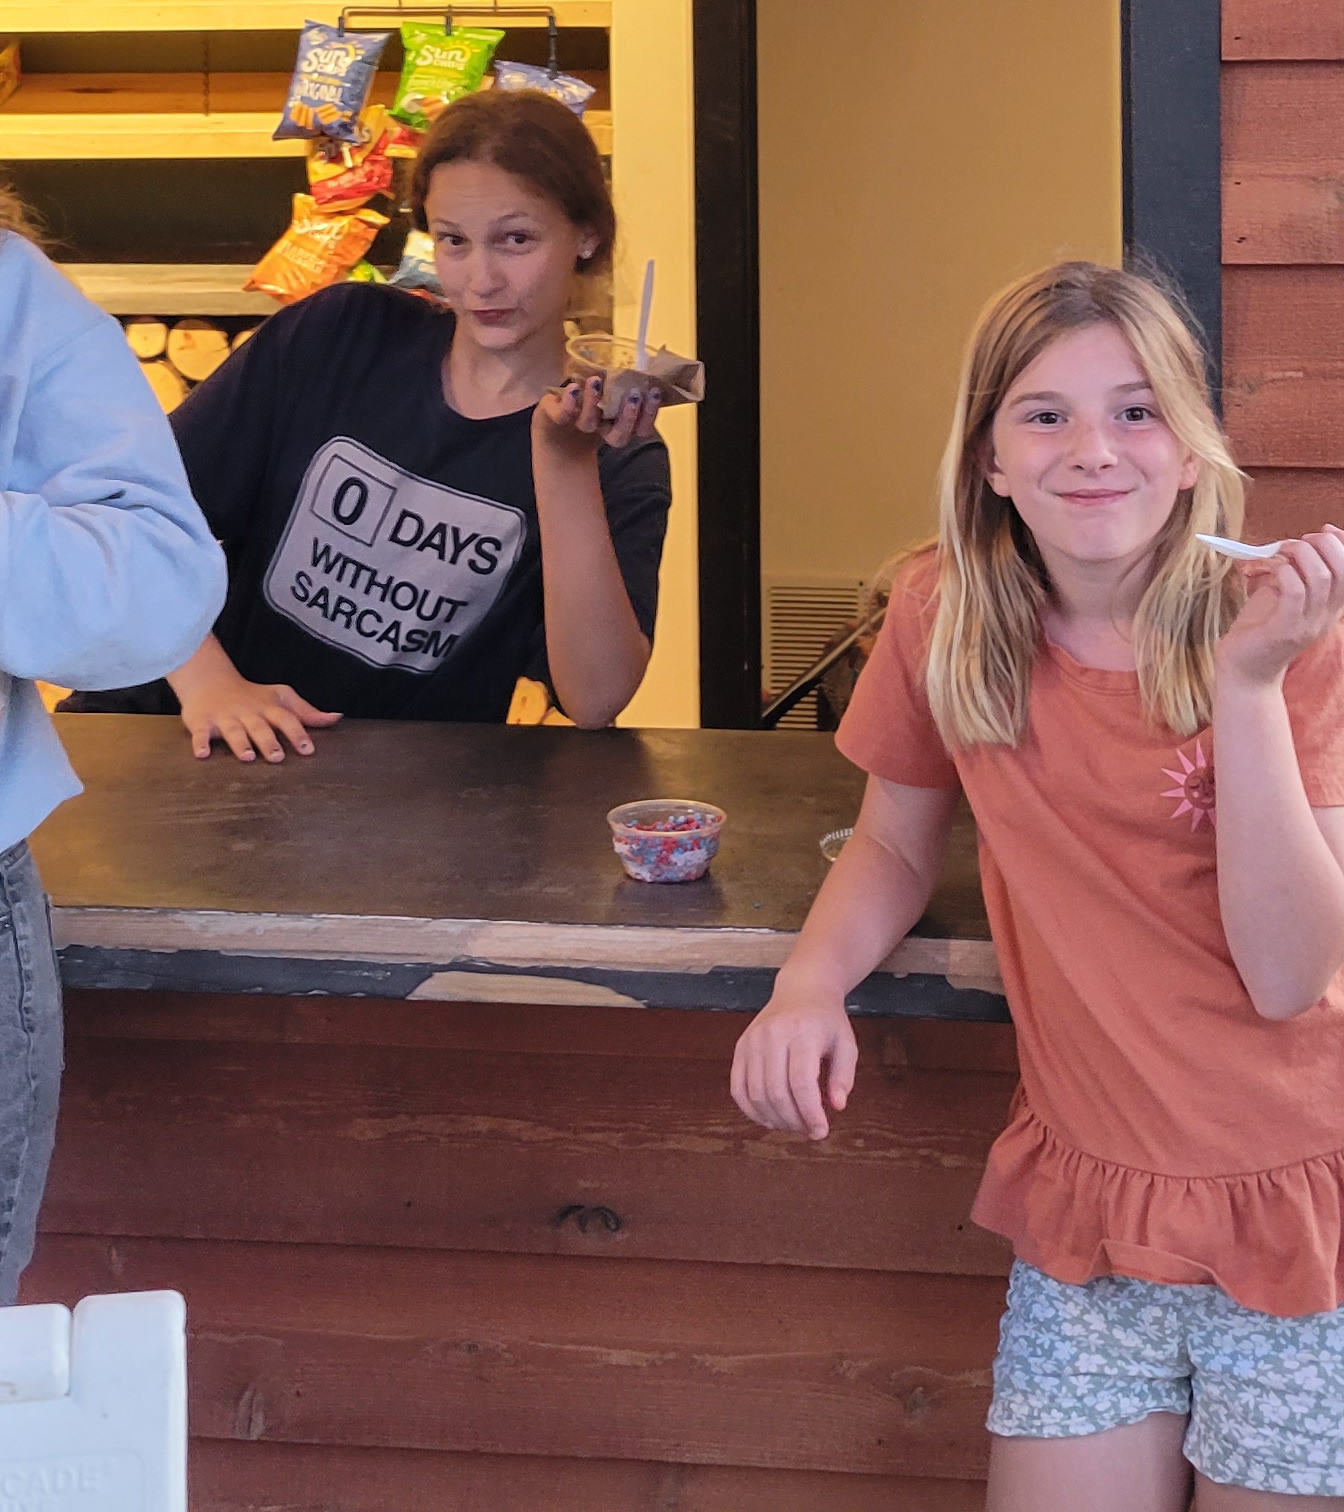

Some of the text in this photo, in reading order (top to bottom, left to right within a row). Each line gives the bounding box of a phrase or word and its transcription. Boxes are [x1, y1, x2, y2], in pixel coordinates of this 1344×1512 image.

[331, 476, 503, 575] 0 DAYS
[290, 570, 460, 658] SARCASM
[310, 536, 469, 624] WITHOUT
